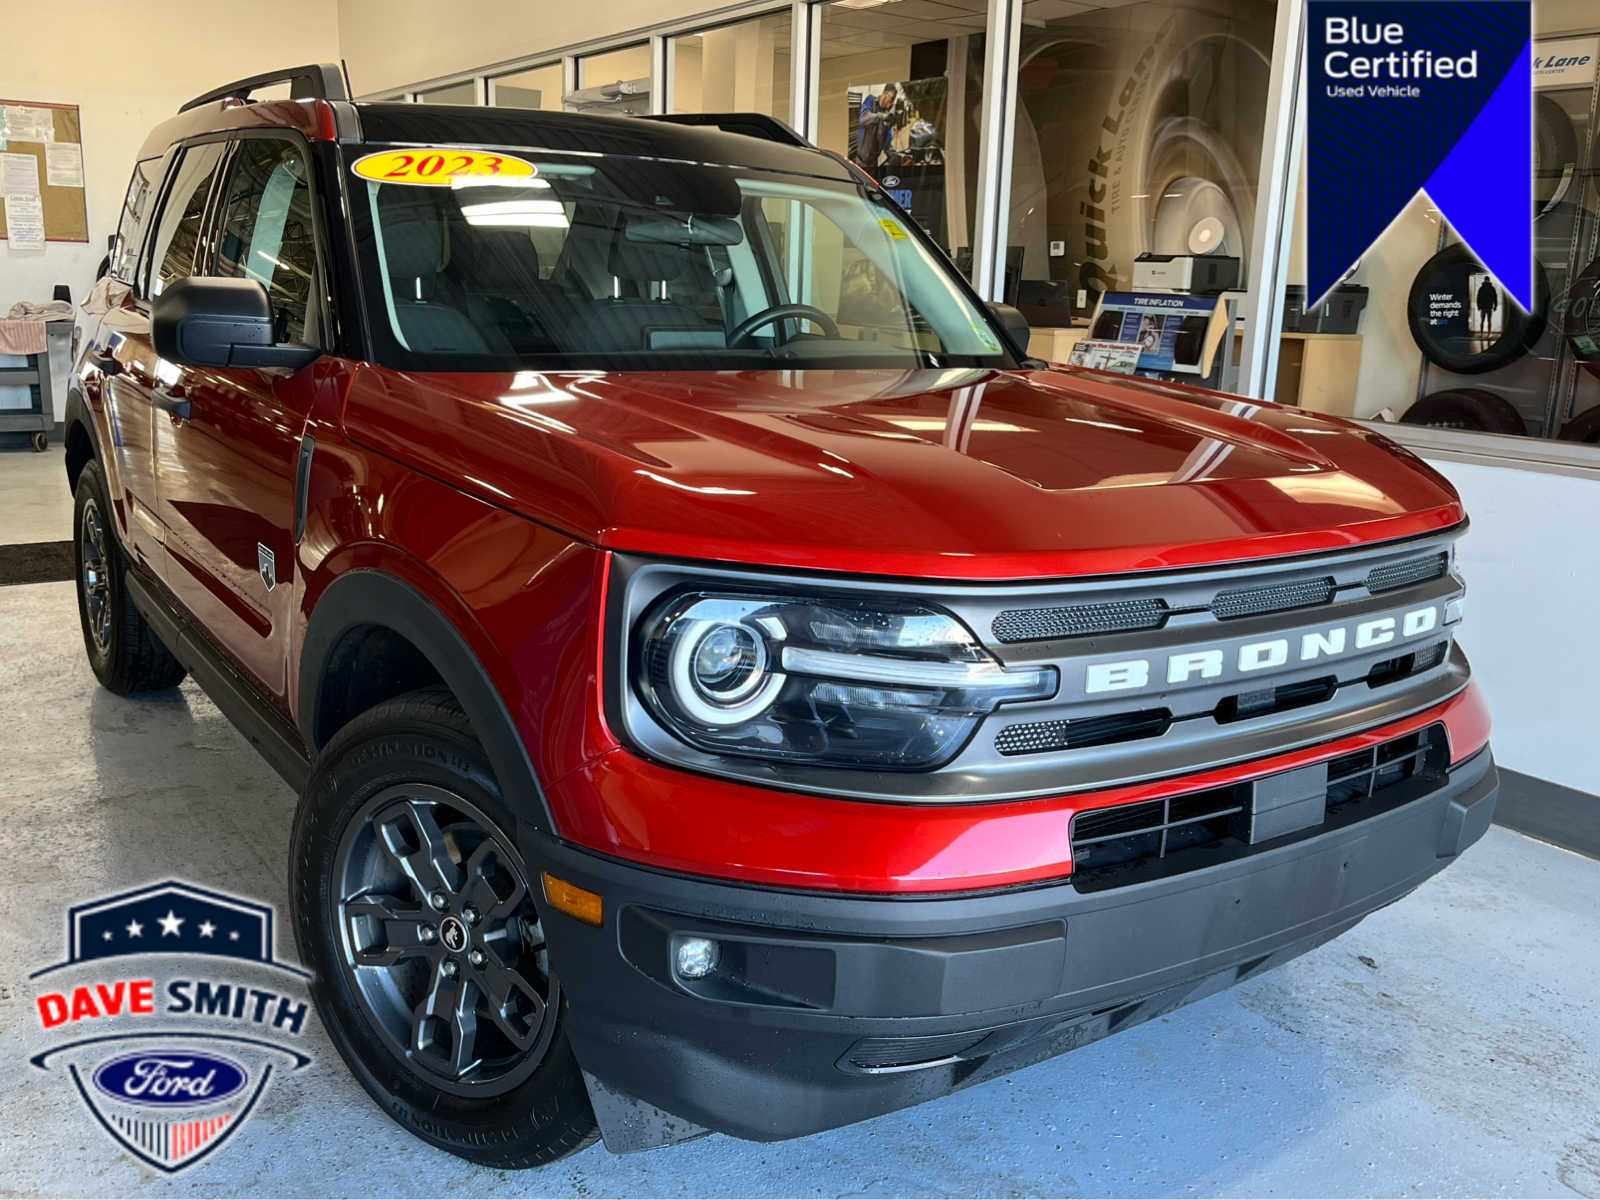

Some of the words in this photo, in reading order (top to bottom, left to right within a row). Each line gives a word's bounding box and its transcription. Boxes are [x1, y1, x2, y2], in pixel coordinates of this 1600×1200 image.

[1544, 55, 1591, 68] Lane
[384, 155, 503, 177] 2023
[1111, 180, 1122, 215] TIRE
[1080, 144, 1118, 302] Quick
[1149, 299, 1185, 308] INFLATION
[1429, 293, 1454, 301] Winter
[1429, 301, 1462, 310] demands
[1430, 310, 1442, 318] the
[1443, 309, 1460, 319] right
[1085, 606, 1437, 694] BRONCO
